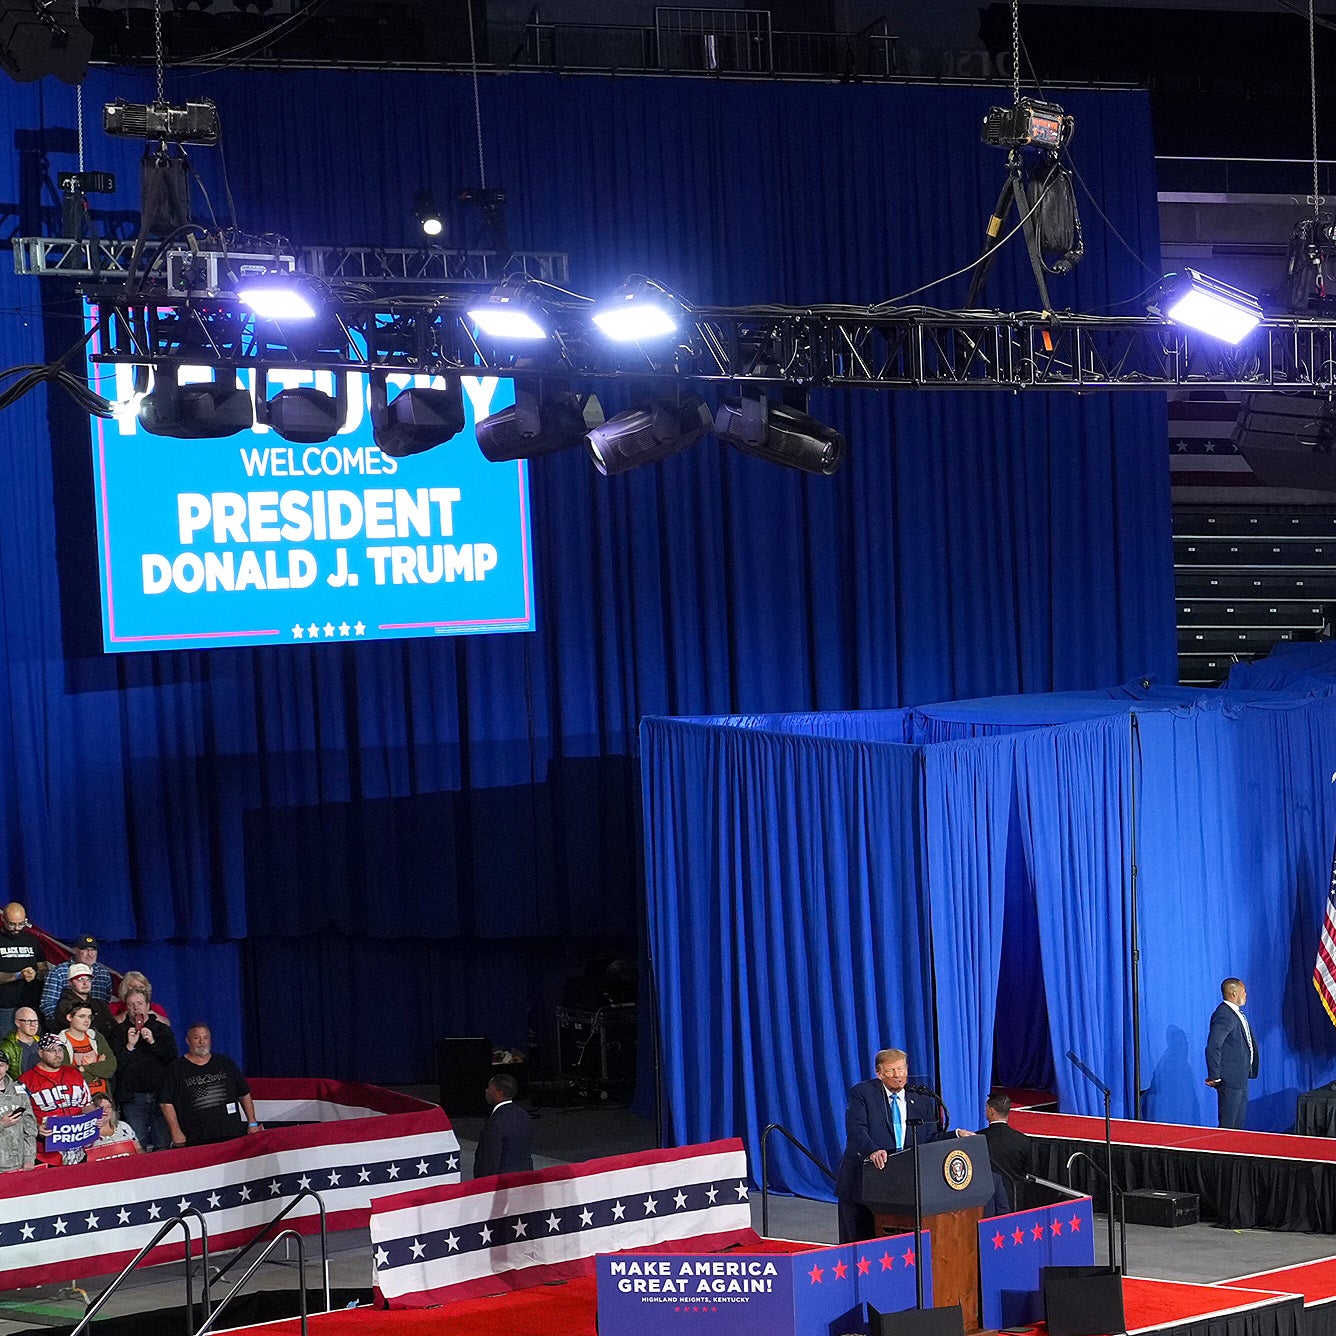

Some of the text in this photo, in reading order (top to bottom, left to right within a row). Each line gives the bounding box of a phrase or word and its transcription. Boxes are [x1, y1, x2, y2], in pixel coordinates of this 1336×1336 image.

[240, 447, 398, 477] WELCOMES
[177, 488, 461, 544] PRESIDENT
[142, 543, 497, 594] DONALD J. TRUMP
[32, 1083, 93, 1112] USA
[52, 1118, 98, 1135] LOWER
[52, 1127, 96, 1144] PRICES
[610, 1262, 778, 1276] MAKE AMERICA
[618, 1279, 773, 1293] GREAT AGAIN!
